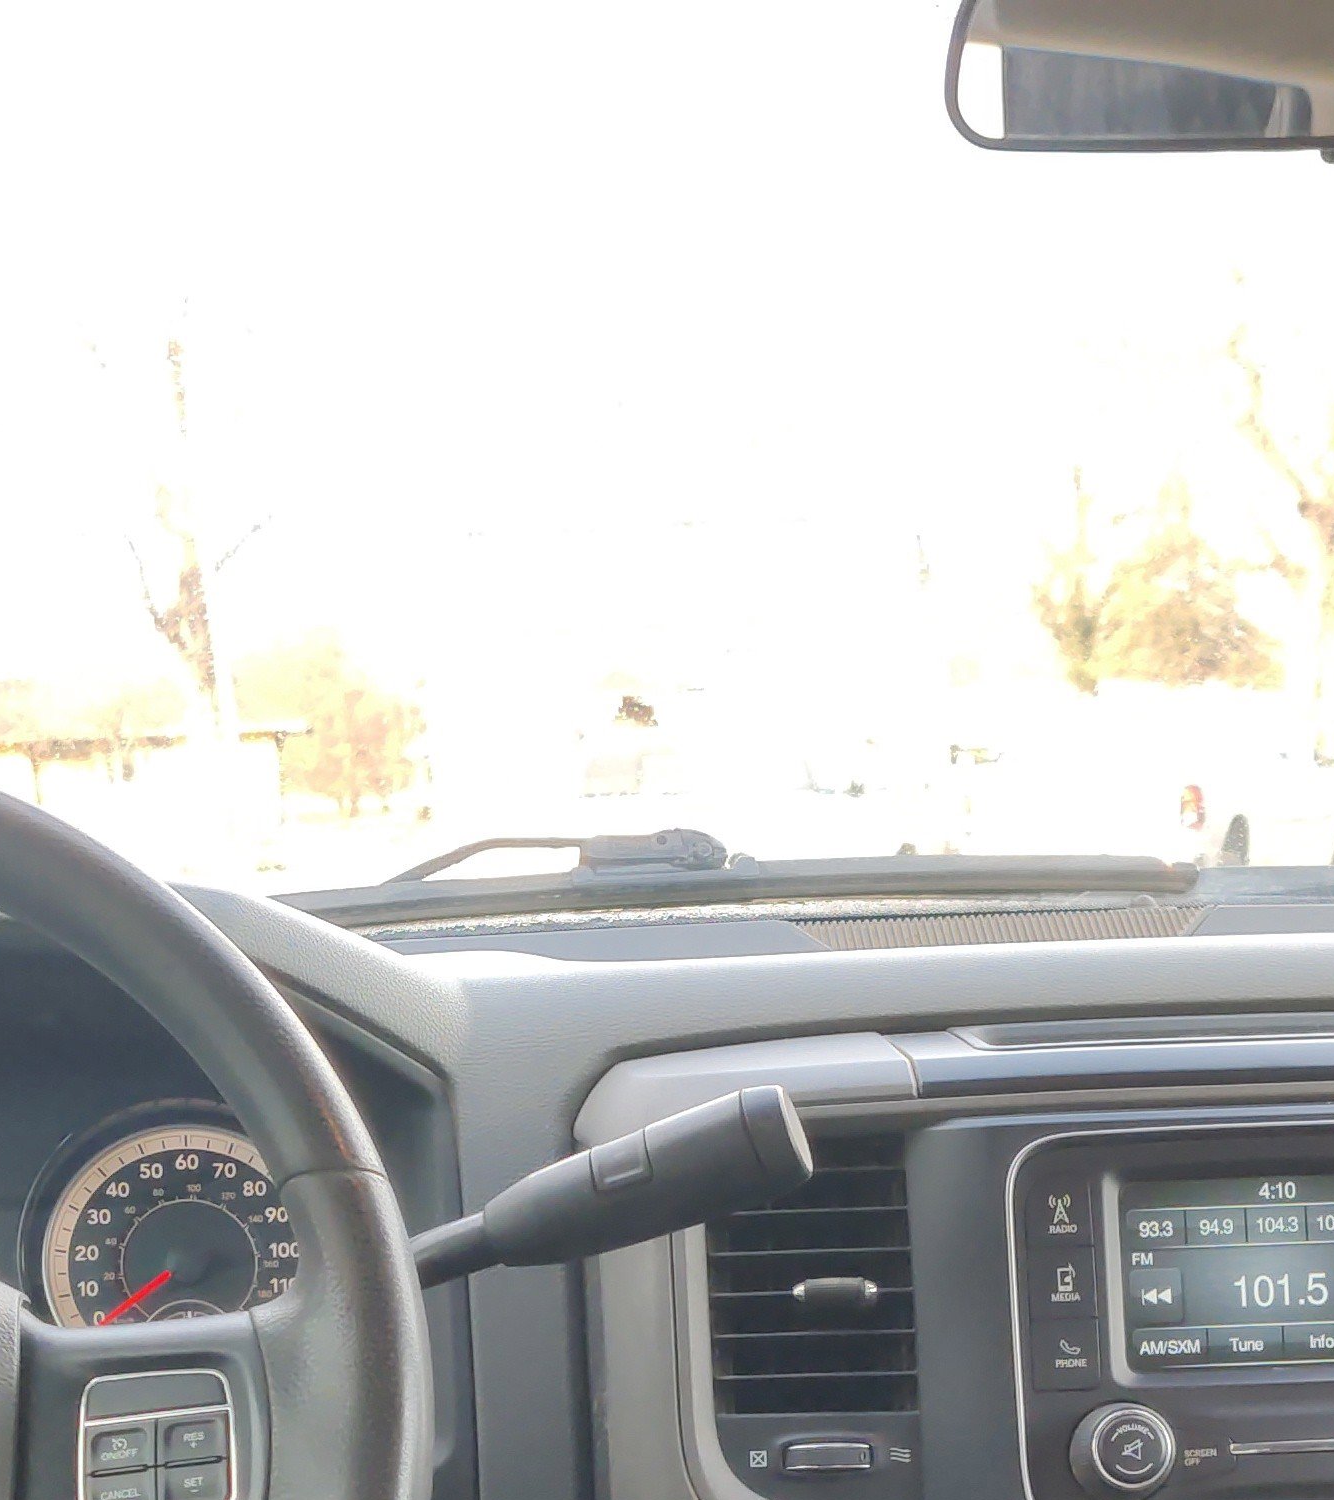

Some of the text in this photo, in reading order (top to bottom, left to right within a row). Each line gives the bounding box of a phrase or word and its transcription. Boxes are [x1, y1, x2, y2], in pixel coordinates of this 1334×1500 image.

[175, 1154, 199, 1170] 60
[139, 1163, 163, 1179] 50
[212, 1163, 237, 1178] 70
[106, 1181, 130, 1198] 40
[242, 1181, 267, 1197] 80
[1259, 1181, 1297, 1200] 4:10
[87, 1208, 111, 1225] 30
[265, 1206, 288, 1223] 90
[1049, 1223, 1078, 1235] RADIO
[1139, 1220, 1174, 1238] 93.3
[1200, 1217, 1234, 1235] 94.9
[1256, 1215, 1299, 1233] 104.3
[74, 1245, 99, 1261] 20
[1132, 1252, 1154, 1266] FM
[77, 1280, 99, 1297] 10
[1051, 1291, 1081, 1302] MEDIA
[1233, 1271, 1329, 1308] 101.5
[1139, 1337, 1201, 1355] AM/SXM
[1228, 1335, 1264, 1352] Tune
[1055, 1357, 1088, 1368] PHONE
[183, 1431, 205, 1442] RES
[183, 1476, 204, 1488] SET
